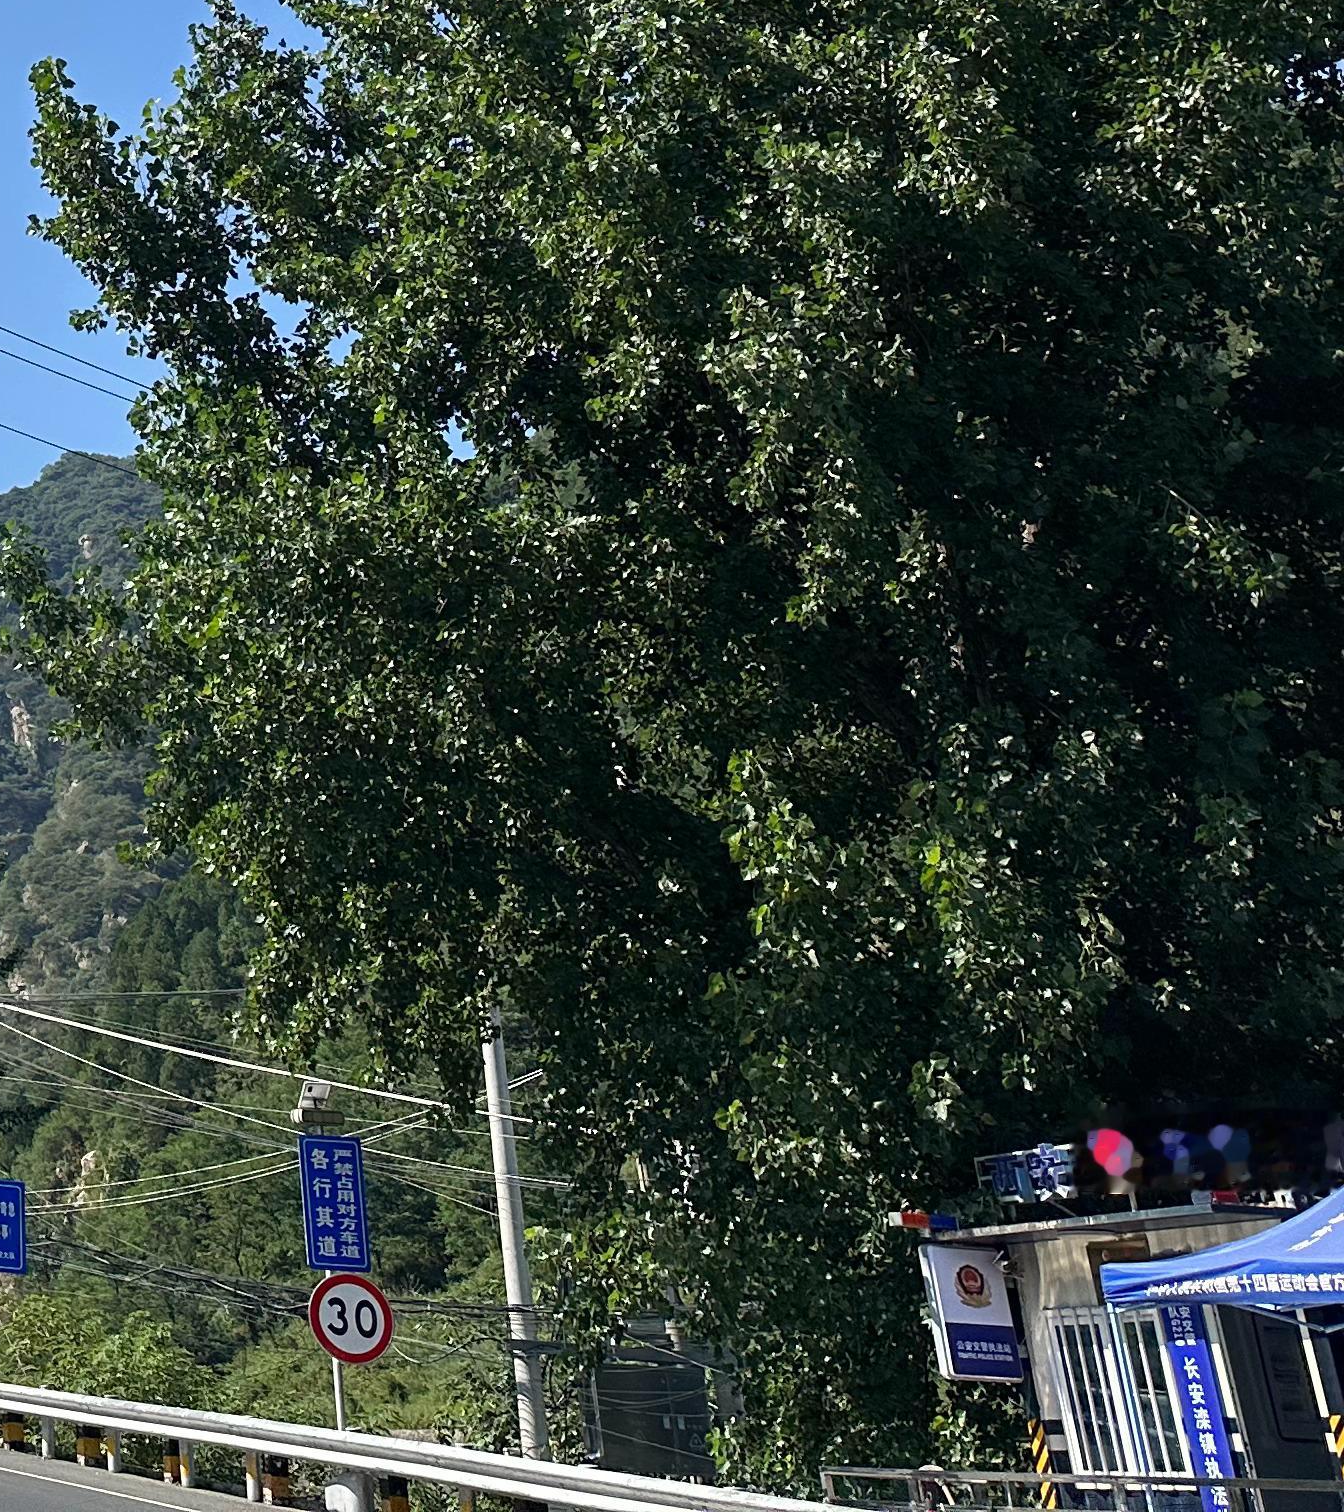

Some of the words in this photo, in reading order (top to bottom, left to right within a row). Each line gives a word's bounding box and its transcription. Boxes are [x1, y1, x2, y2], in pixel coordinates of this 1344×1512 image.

[311, 1148, 338, 1257] 各行其道
[333, 1148, 361, 1259] 严禁占用对方车道
[327, 1296, 378, 1339] 30
[1184, 1356, 1232, 1512] 长安滦镇执法
